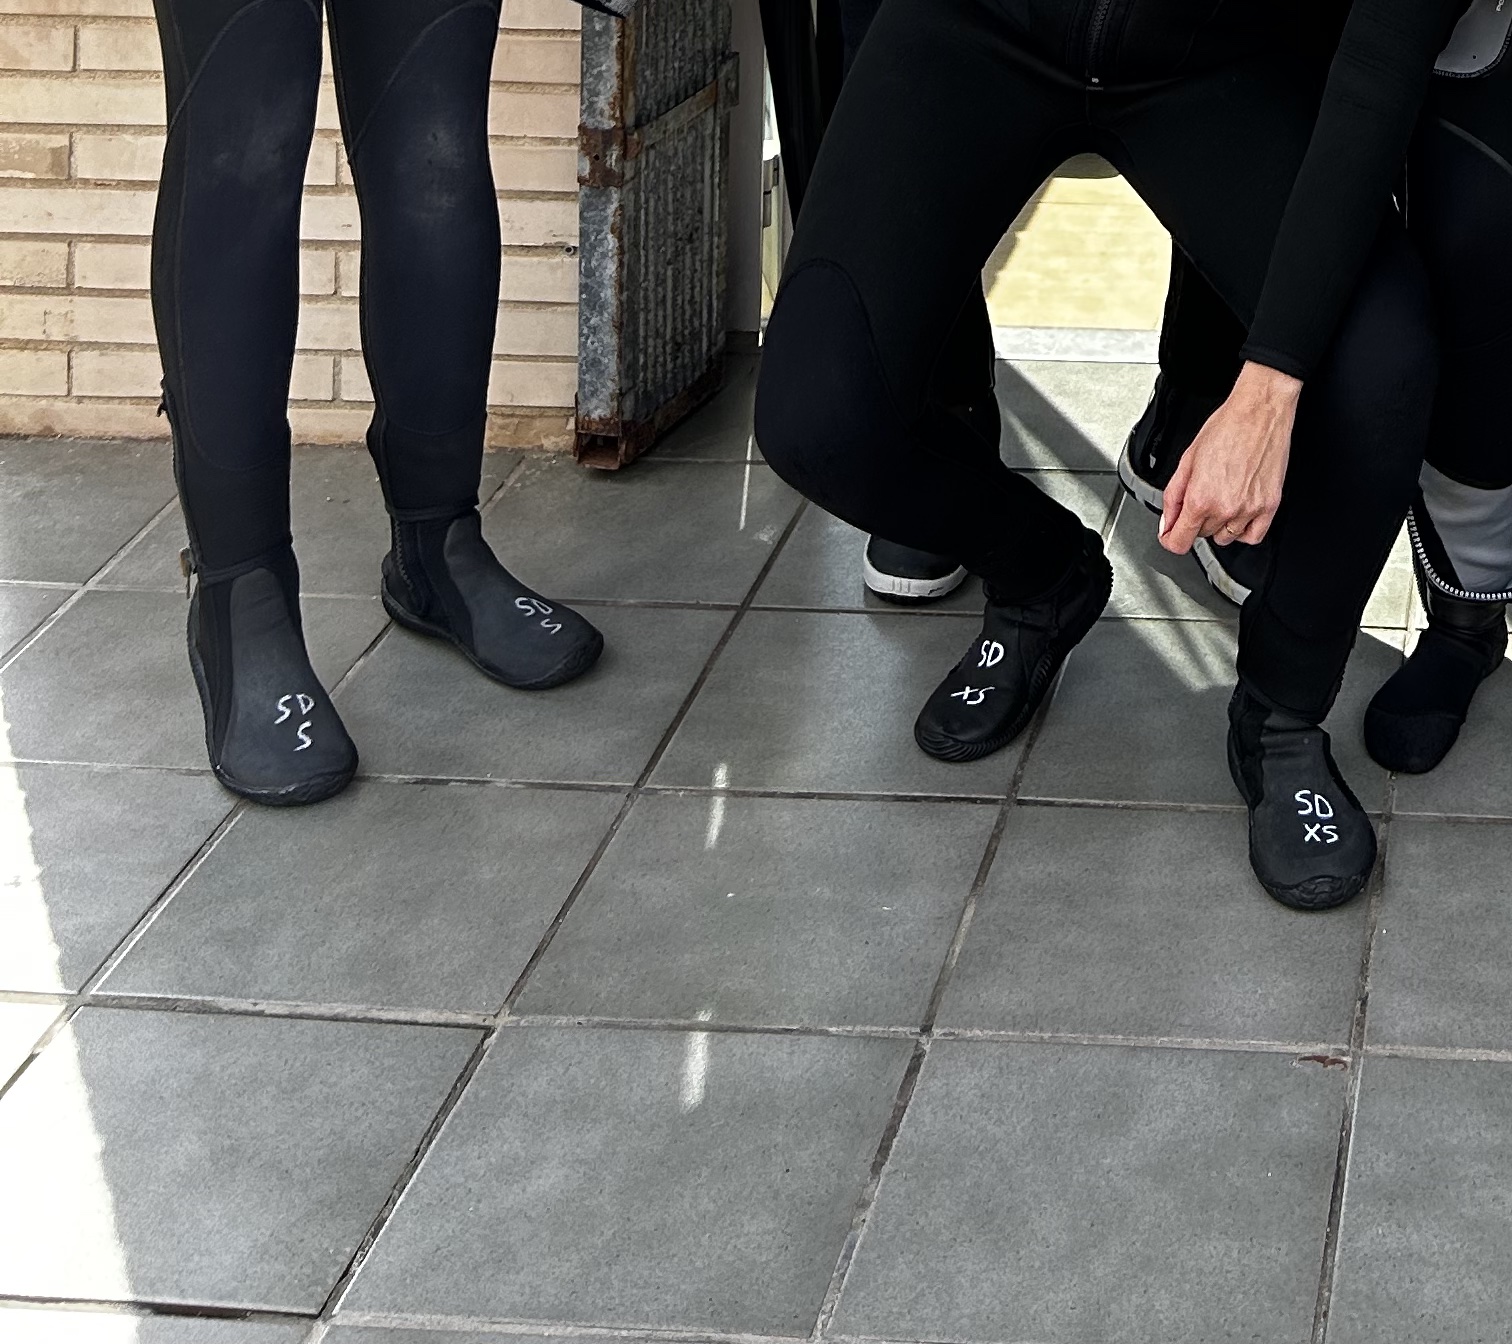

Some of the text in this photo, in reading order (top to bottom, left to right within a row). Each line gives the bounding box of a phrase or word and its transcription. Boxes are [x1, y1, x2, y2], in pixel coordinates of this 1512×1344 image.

[514, 596, 553, 617] SD
[540, 618, 562, 635] S
[977, 639, 1005, 668] SD
[274, 692, 316, 724] SD
[950, 685, 996, 706] XS
[293, 720, 313, 752] S
[1294, 789, 1334, 820] SD
[1303, 822, 1340, 844] XS
